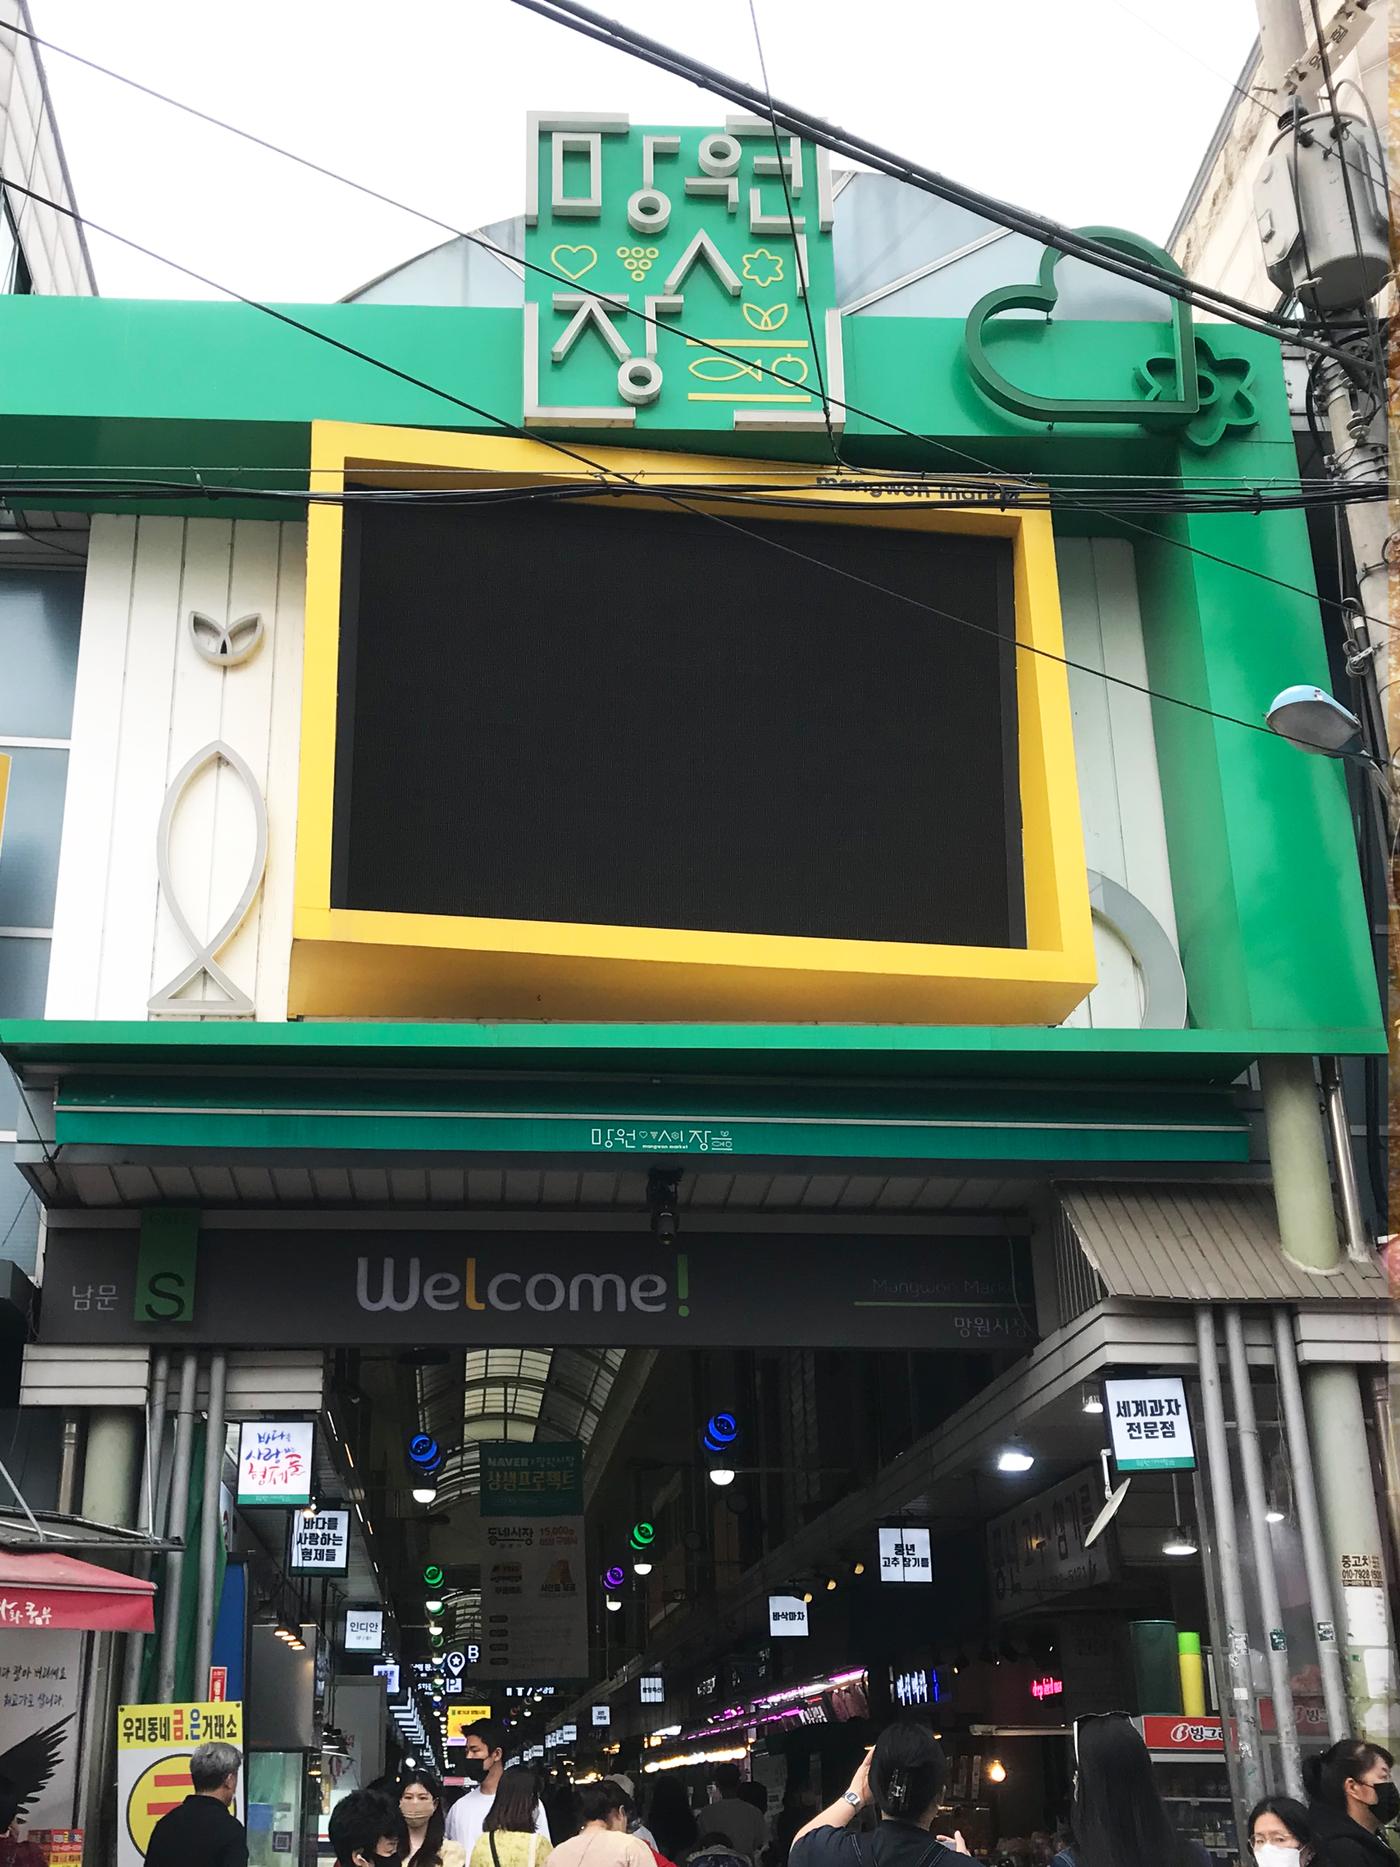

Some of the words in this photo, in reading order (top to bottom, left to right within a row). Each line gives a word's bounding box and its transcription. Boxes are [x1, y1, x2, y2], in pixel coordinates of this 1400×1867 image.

[356, 1254, 690, 1317] Welcome!
[72, 1284, 119, 1311] 남문
[144, 1272, 186, 1320] S
[1116, 1398, 1182, 1418] 세계과자
[1126, 1420, 1176, 1440] 전문점
[487, 1456, 528, 1467] NAVER
[303, 1517, 338, 1531] 바다를
[296, 1532, 344, 1546] 사랑하는
[487, 1527, 534, 1546] 동네시장
[301, 1547, 337, 1561] 형제들
[894, 1543, 916, 1556] 풍년
[882, 1557, 900, 1568] 고추
[350, 1621, 379, 1633] 인디안
[467, 1645, 480, 1660] B
[123, 1716, 171, 1743] 우리동네
